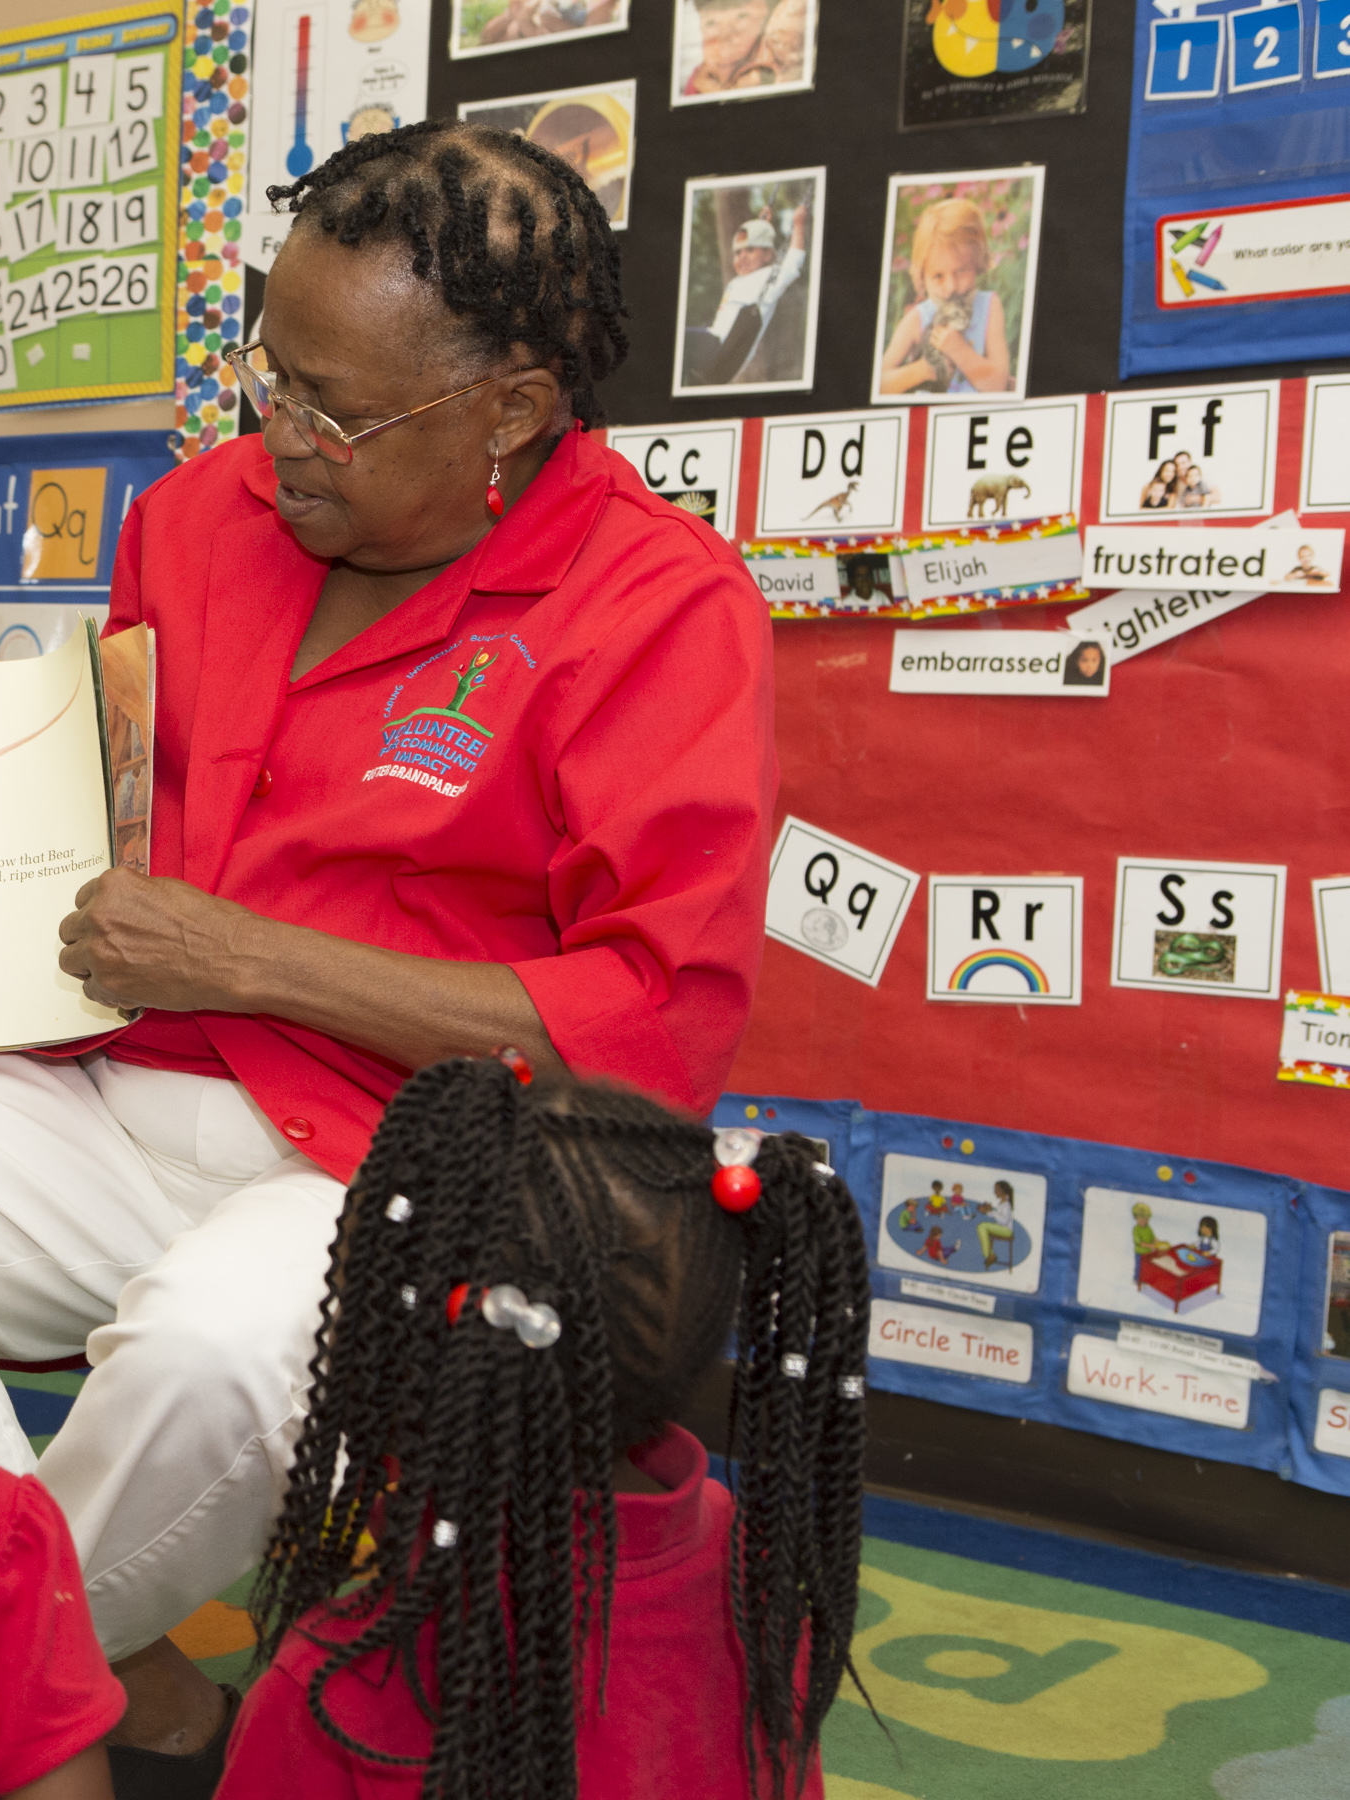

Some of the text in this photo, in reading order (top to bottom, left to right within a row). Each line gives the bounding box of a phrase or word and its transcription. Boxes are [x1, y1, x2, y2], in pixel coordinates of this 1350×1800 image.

[1178, 40, 1192, 81] 1
[1253, 26, 1280, 70] 2
[27, 83, 48, 125] 3
[75, 71, 95, 114] 4
[127, 66, 150, 111] 5
[18, 139, 53, 183] 10
[70, 135, 96, 179] 11
[108, 120, 150, 168] 12
[14, 198, 45, 251] 17
[66, 201, 103, 245] 18
[113, 195, 145, 243] 19
[6, 280, 49, 331] 24
[52, 264, 98, 312] 25
[100, 263, 148, 306] 26
[31, 482, 94, 565] Qq
[924, 558, 987, 586] Elijah
[1093, 545, 1266, 577] frustrated
[759, 573, 815, 593] David
[510, 633, 537, 669] CARING
[901, 652, 1061, 674] embarrassed
[394, 751, 451, 775] IMPACT
[19, 852, 45, 866] that
[48, 848, 76, 862] Bear
[9, 870, 35, 884] ripe
[881, 1319, 1020, 1366] Circle Time
